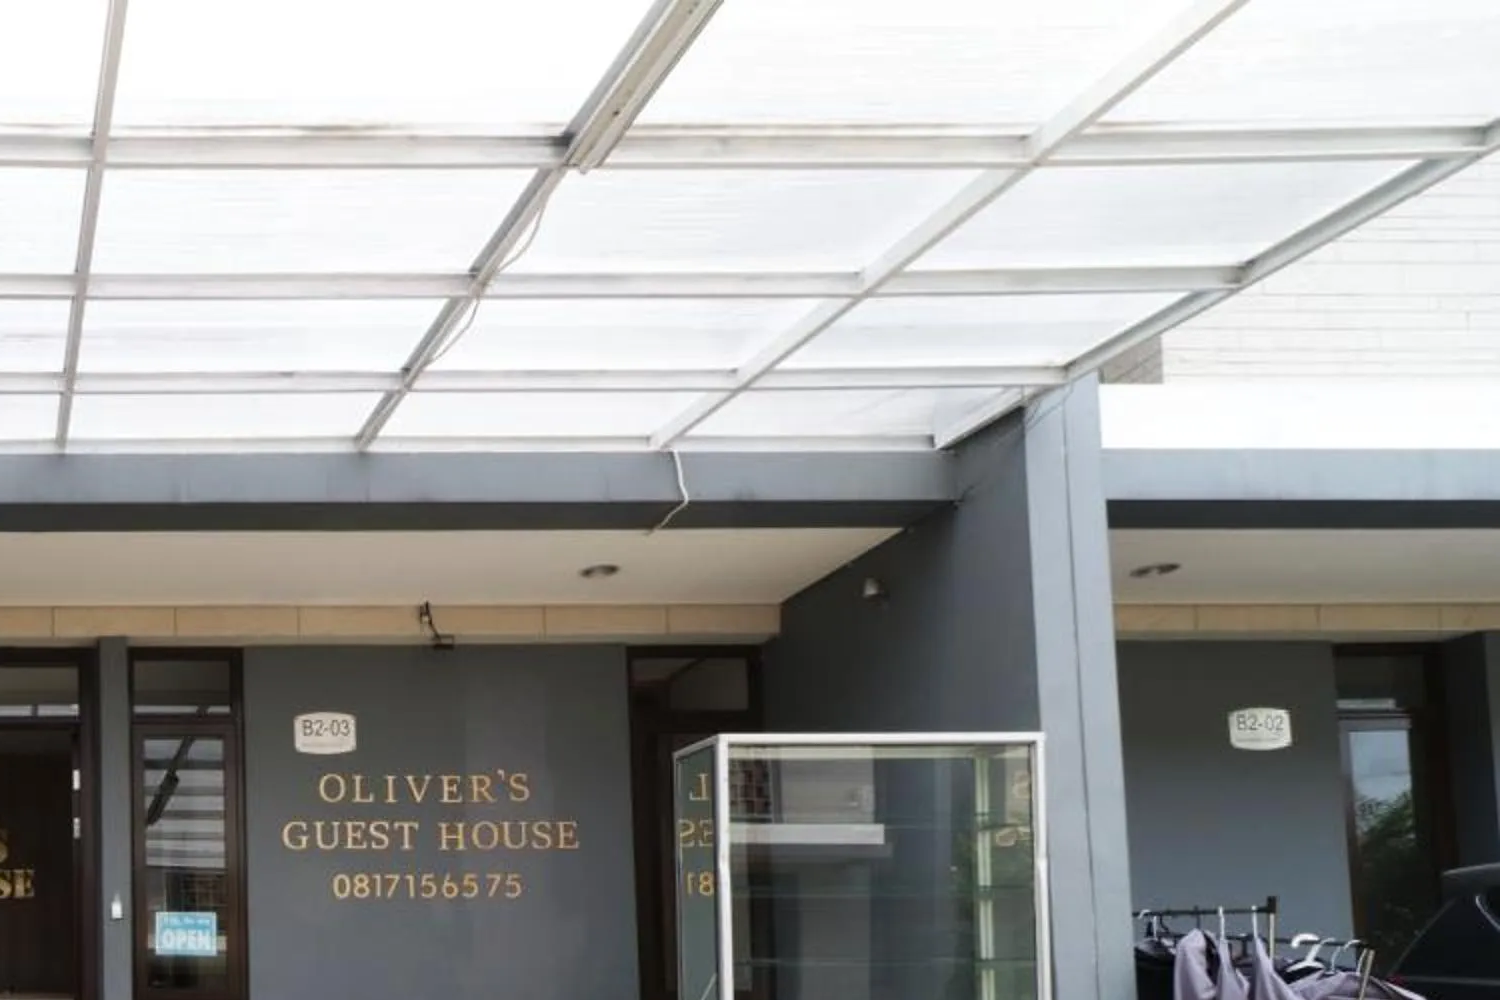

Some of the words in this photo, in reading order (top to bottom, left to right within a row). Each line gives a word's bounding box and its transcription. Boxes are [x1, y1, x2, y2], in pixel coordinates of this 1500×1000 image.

[302, 719, 350, 737] B2-03
[1236, 713, 1284, 731] B2-02
[318, 769, 531, 803] OLIVER'S
[282, 820, 419, 851] GUEST
[438, 820, 580, 851] HOUSE
[332, 872, 523, 899] 0817156575
[163, 928, 211, 951] OPEN
